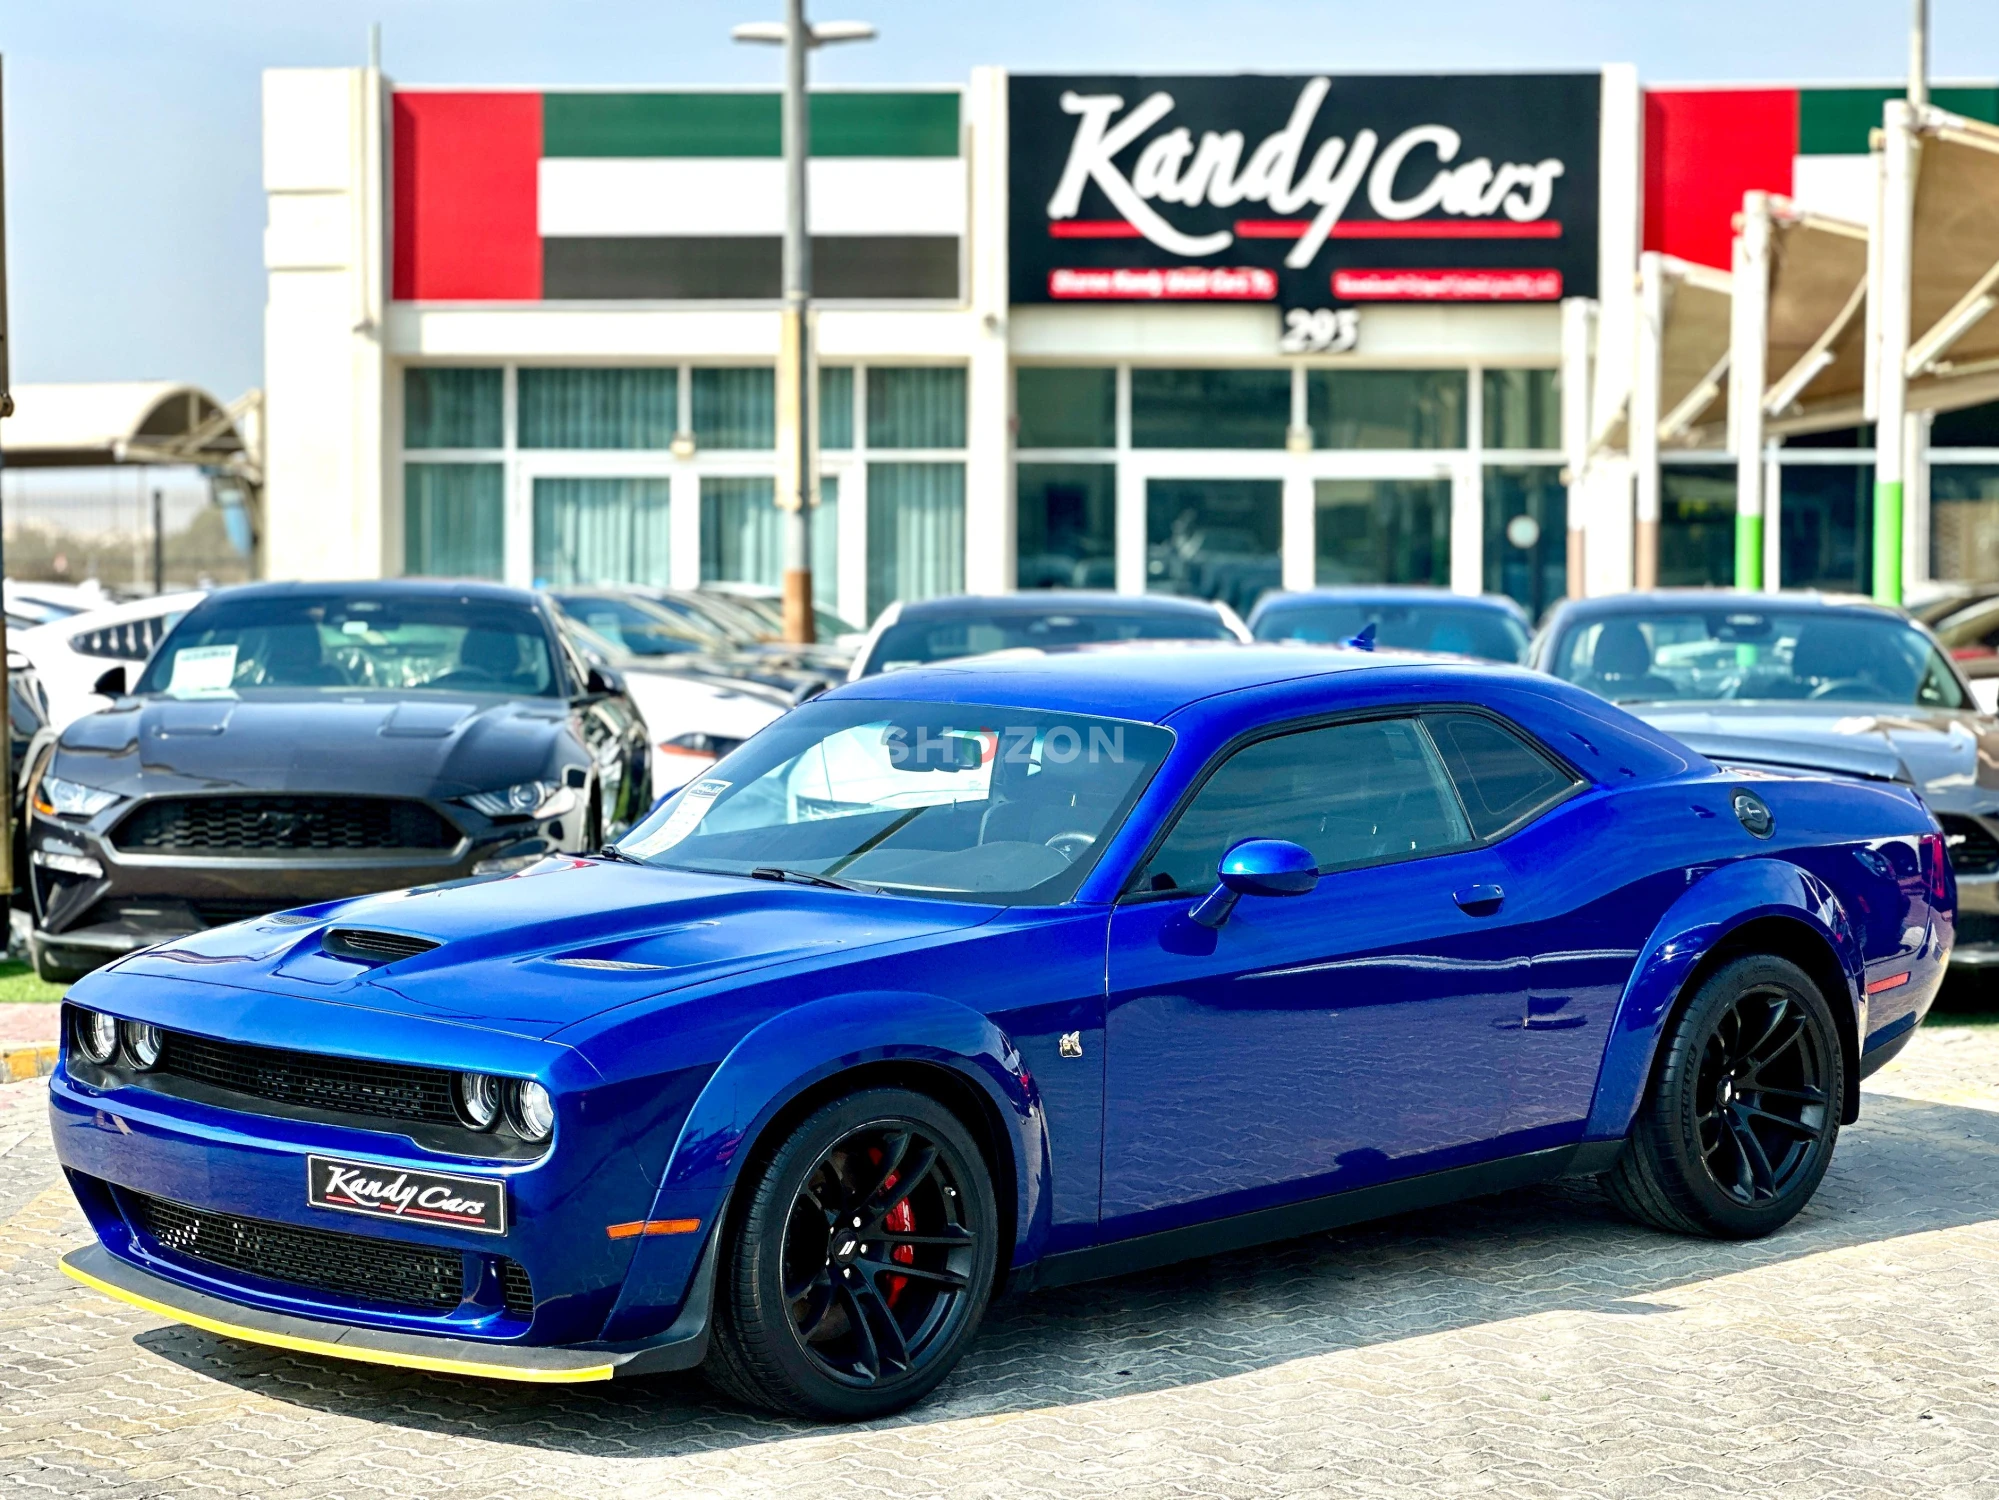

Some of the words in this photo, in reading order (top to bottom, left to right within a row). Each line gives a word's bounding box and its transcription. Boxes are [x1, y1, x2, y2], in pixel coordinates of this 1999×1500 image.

[1047, 76, 1378, 268] Kandy
[1368, 124, 1565, 221] Cars
[1682, 1049, 1696, 1139] MICHELIN
[325, 1166, 418, 1214] Kandy
[417, 1186, 486, 1215] Cars
